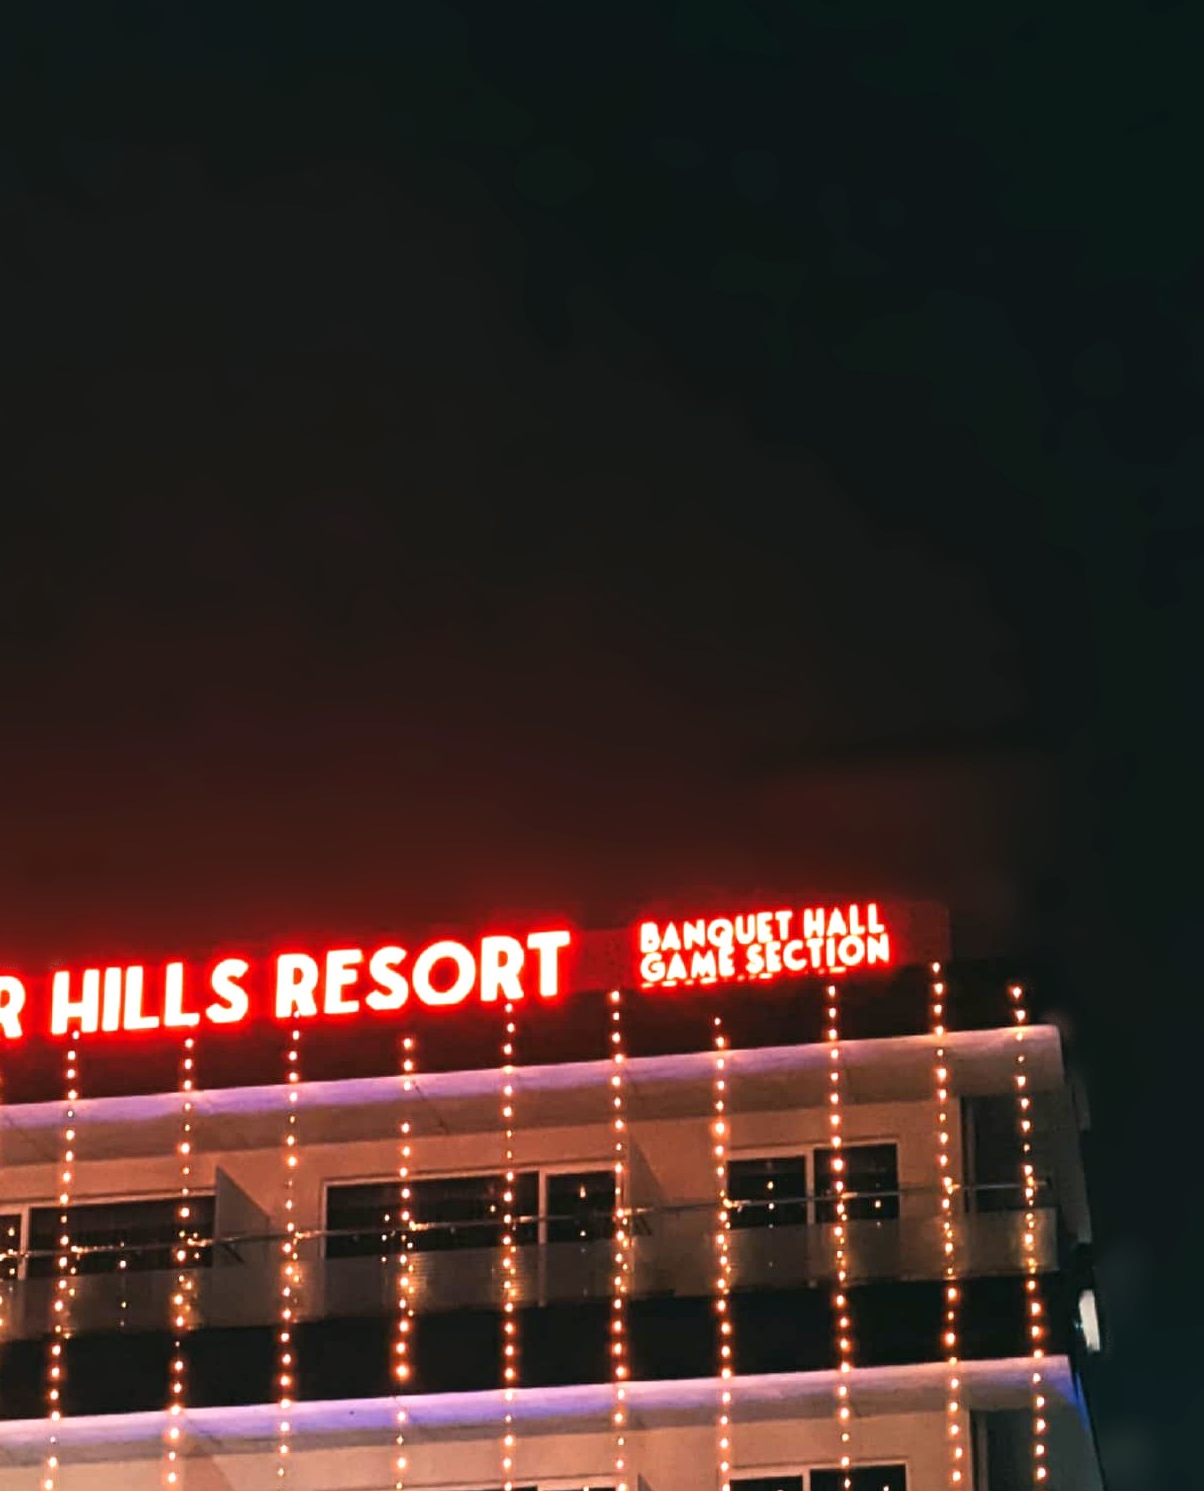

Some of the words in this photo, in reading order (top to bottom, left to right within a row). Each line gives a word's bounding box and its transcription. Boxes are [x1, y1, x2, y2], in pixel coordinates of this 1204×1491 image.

[640, 910, 793, 953] BANQUET
[803, 903, 885, 937] HALL
[640, 945, 735, 982] GAME
[745, 933, 890, 974] SECTION
[51, 959, 249, 1035] HILLS
[275, 931, 571, 1018] RESORT
